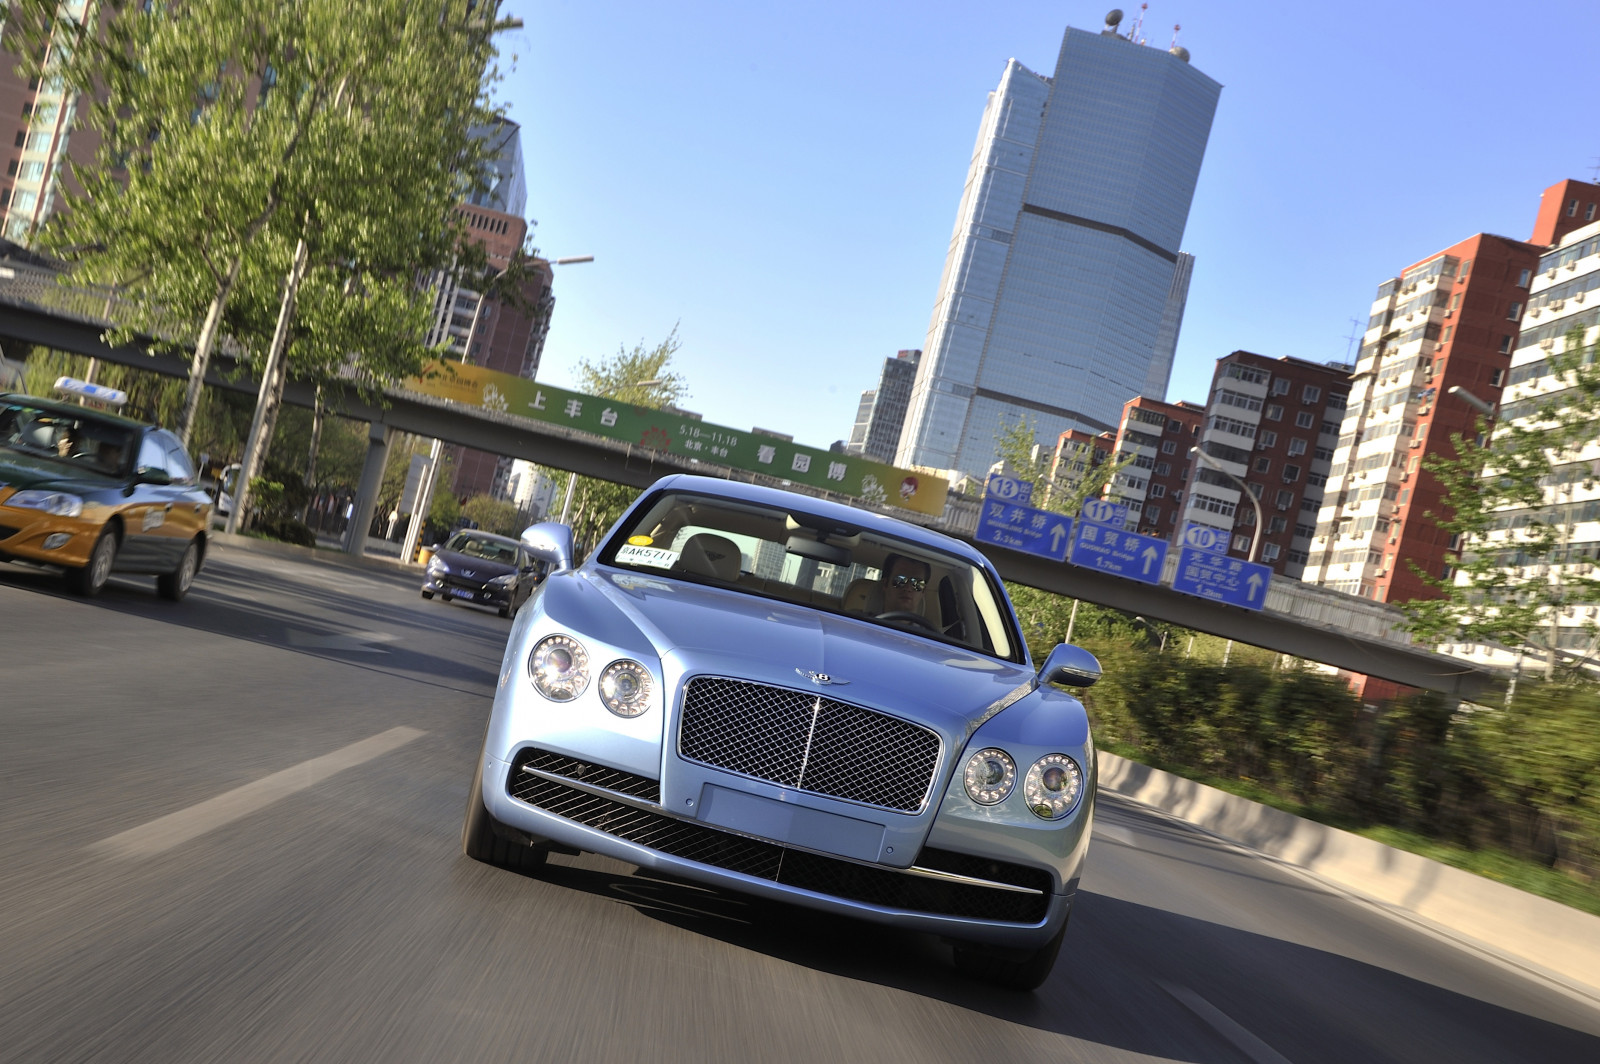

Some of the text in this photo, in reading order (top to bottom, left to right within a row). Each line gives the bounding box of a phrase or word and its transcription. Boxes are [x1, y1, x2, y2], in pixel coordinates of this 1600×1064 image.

[757, 444, 847, 482] 看园博
[996, 479, 1013, 497] 13
[1017, 483, 1032, 502] 出口
[988, 503, 1047, 529] 双井桥
[1092, 503, 1108, 520] 11
[1081, 525, 1140, 552] 国贸桥
[1194, 529, 1210, 547] 10
[1096, 556, 1122, 571] 1.7km
[1190, 552, 1243, 572] 光华路
[1185, 565, 1240, 587] 国贸中心
